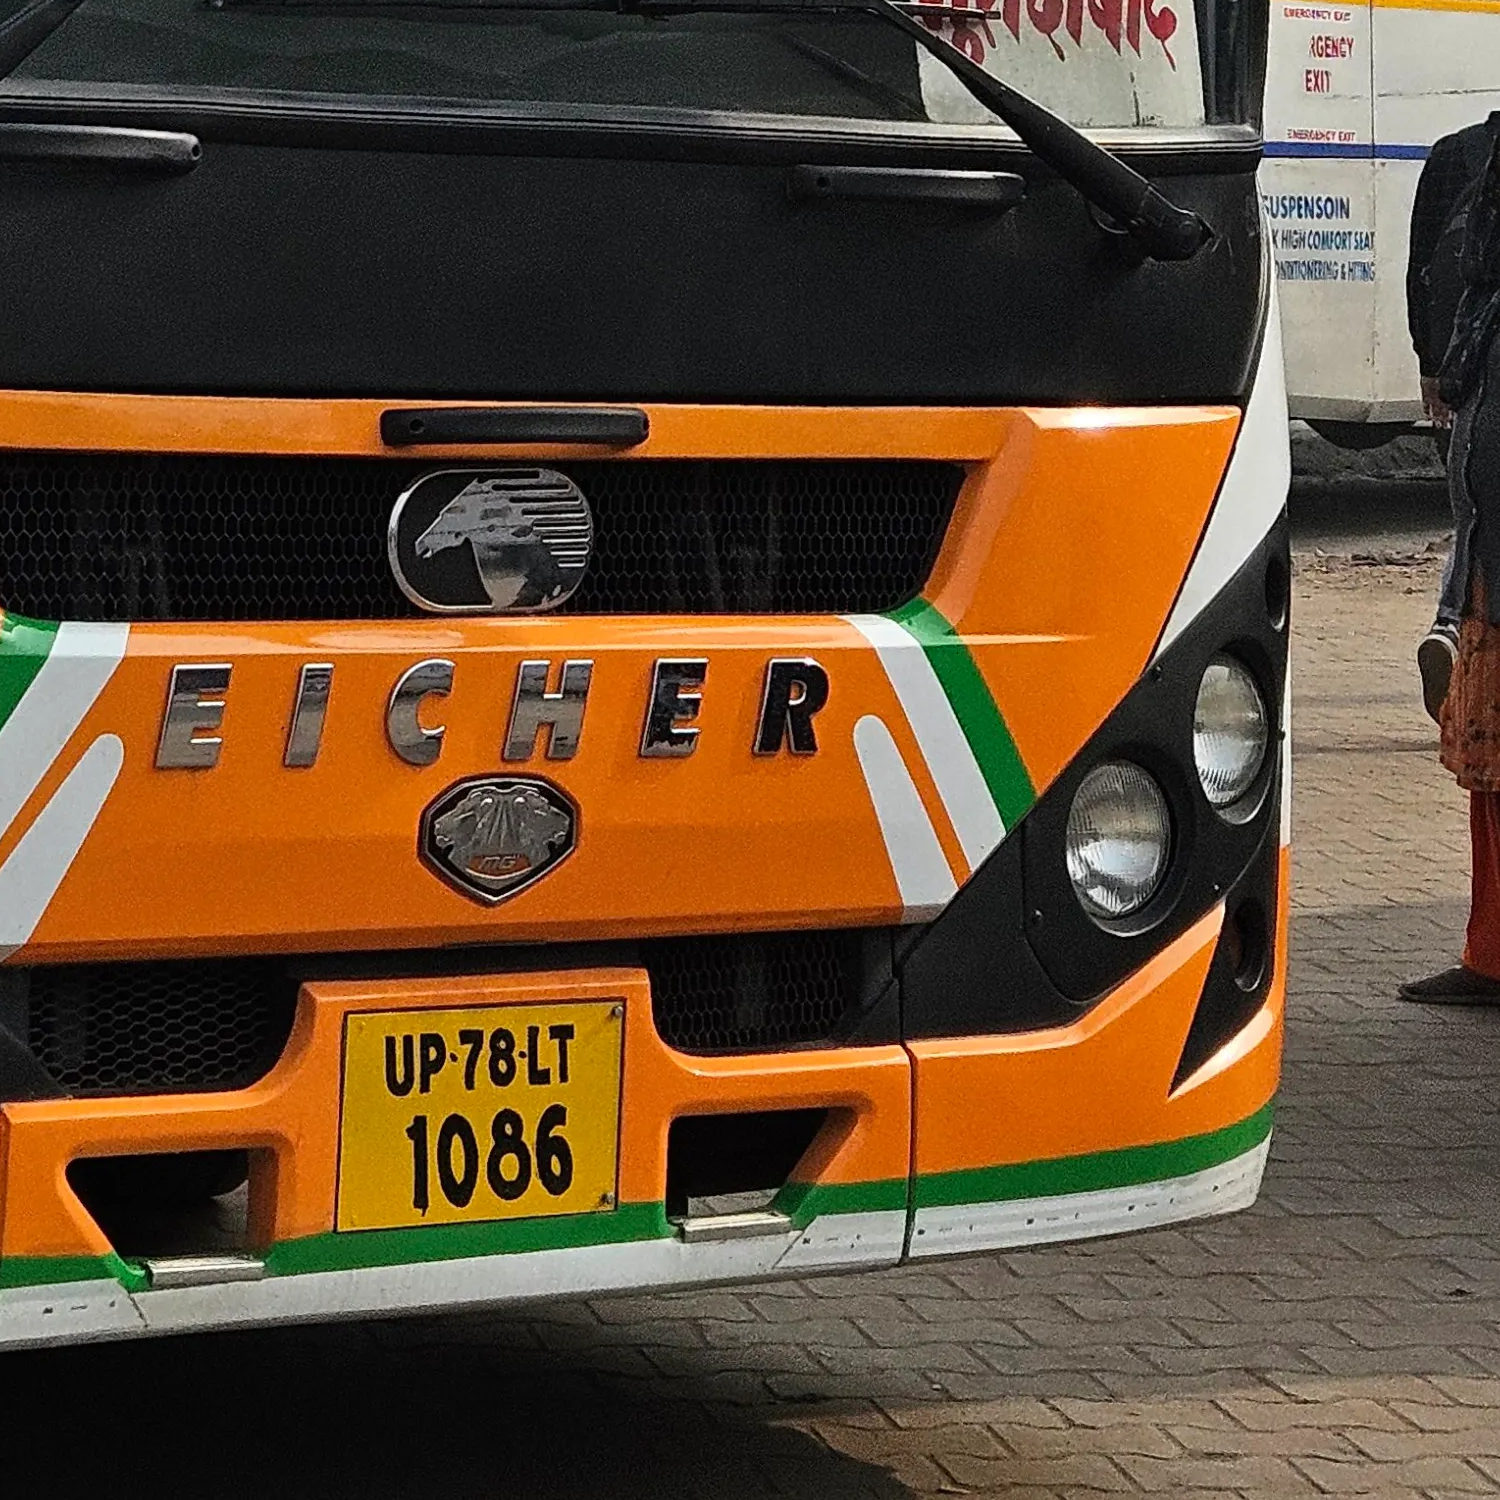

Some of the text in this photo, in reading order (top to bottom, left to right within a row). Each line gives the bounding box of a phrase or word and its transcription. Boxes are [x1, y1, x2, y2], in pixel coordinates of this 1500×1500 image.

[1305, 68, 1331, 93] EXIT
[1307, 229, 1352, 251] COMFORT
[1354, 231, 1375, 251] SEAT
[155, 658, 830, 768] EICHER
[405, 1102, 573, 1217] 1086
